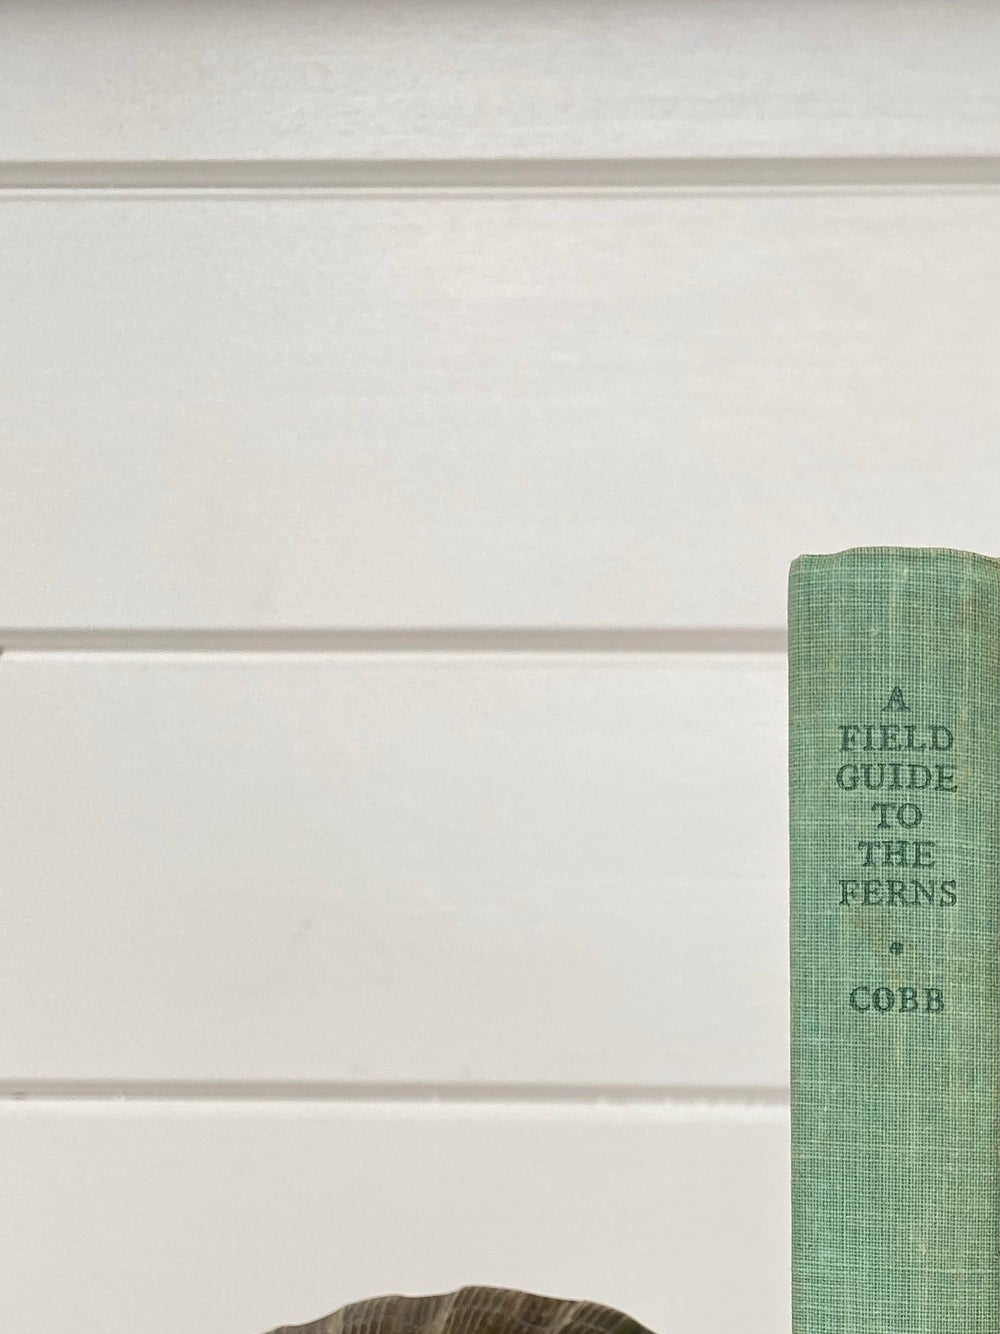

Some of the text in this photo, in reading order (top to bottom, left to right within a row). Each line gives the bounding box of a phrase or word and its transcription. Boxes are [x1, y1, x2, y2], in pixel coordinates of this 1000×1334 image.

[883, 685, 909, 711] A
[838, 725, 954, 752] FIELD
[836, 763, 958, 793] GUIDE
[872, 802, 922, 830] TO
[859, 840, 936, 869] THE
[838, 879, 958, 907] FERNS
[850, 987, 945, 1014] COBB
